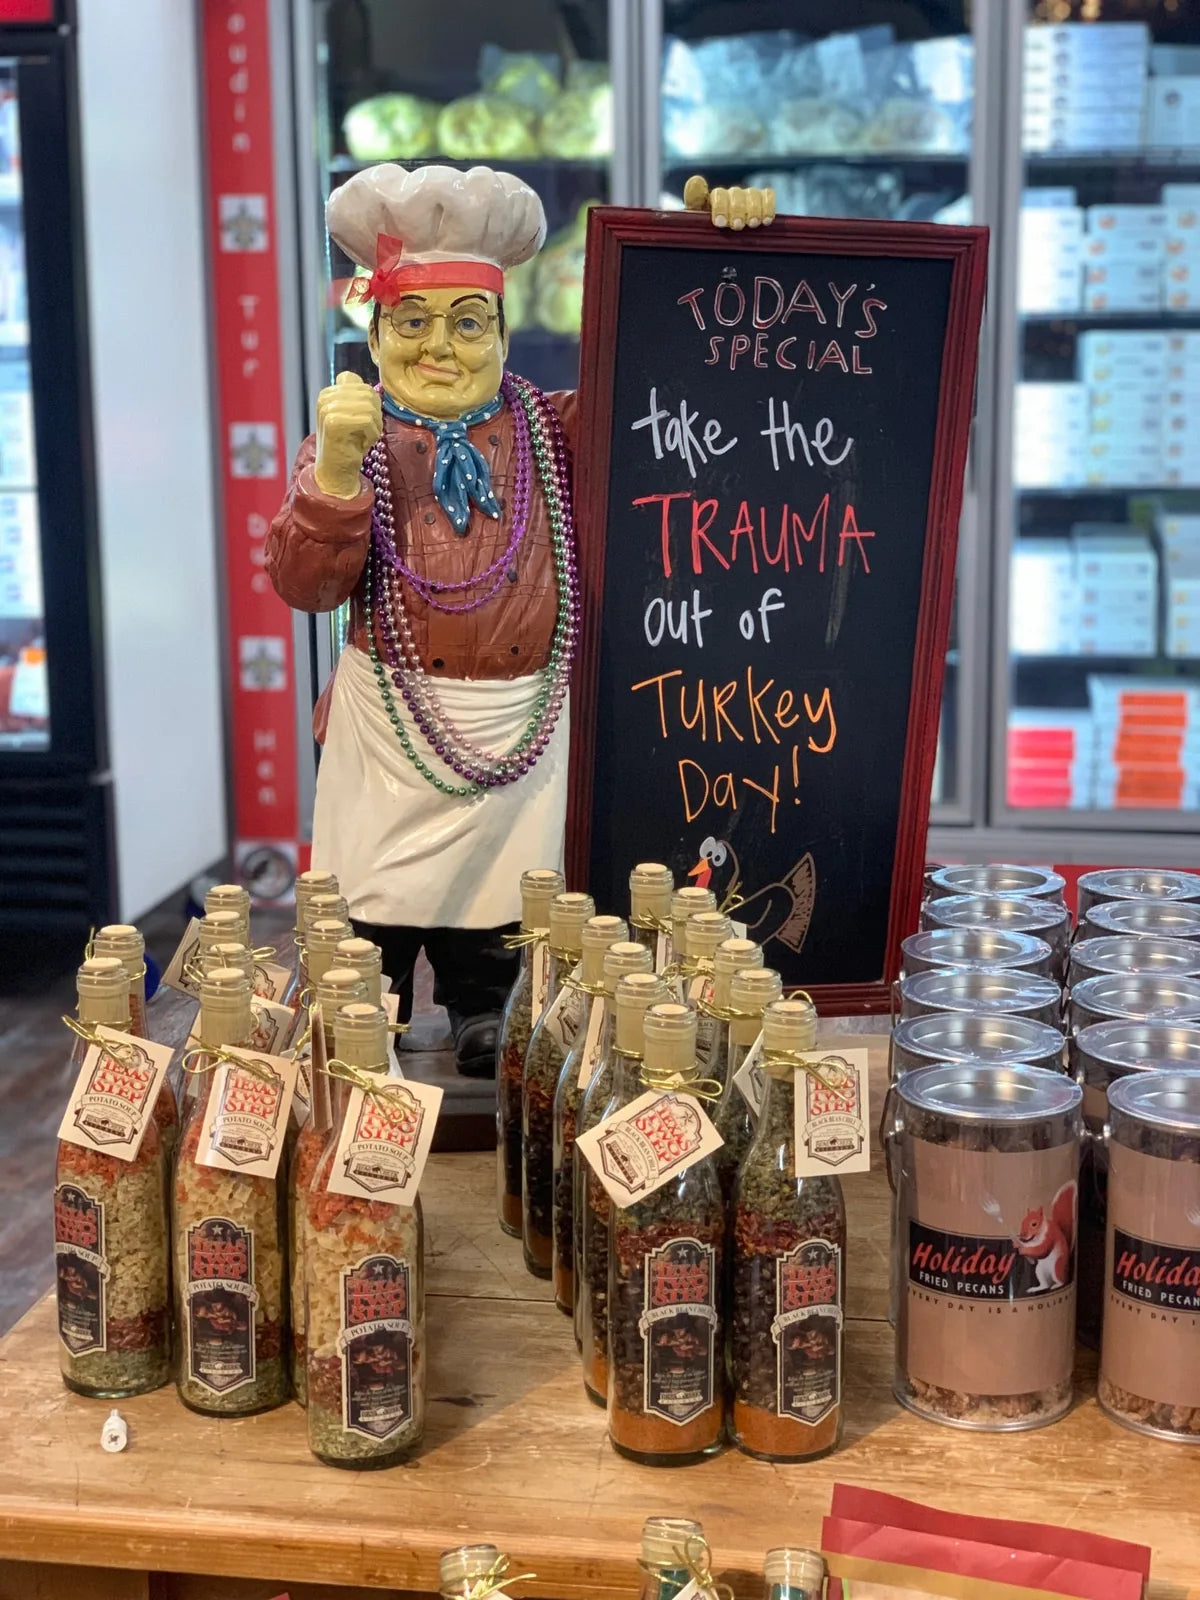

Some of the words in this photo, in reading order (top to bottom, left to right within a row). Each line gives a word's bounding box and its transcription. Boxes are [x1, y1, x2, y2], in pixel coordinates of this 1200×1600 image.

[704, 332, 872, 374] SPECIAL
[631, 386, 738, 478] take
[760, 397, 854, 471] the
[632, 493, 876, 578] TRAUMA
[644, 589, 713, 648] out
[739, 587, 785, 643] of
[99, 1068, 146, 1092] TWO
[230, 1075, 278, 1097] TEXAS
[92, 1080, 143, 1104] STEP
[228, 1088, 276, 1106] TWO
[88, 1095, 118, 1107] POTATO
[119, 1100, 138, 1117] SOUP
[224, 1099, 273, 1120] STEP
[809, 1099, 856, 1116] STEP
[222, 1115, 252, 1125] POTATO
[252, 1119, 272, 1133] SOUP
[647, 1113, 681, 1156] TWO
[359, 1125, 413, 1148] STEP
[635, 1117, 673, 1162] STEP
[357, 1143, 389, 1153] POTATO
[390, 1148, 410, 1162] SOUP
[191, 1236, 247, 1253] TEXAS
[78, 1249, 98, 1263] SOUP
[192, 1252, 247, 1269] TWO
[911, 1241, 1017, 1285] Holiday
[192, 1262, 248, 1280] STEP
[193, 1281, 223, 1291] POTATO
[225, 1281, 248, 1292] SOUP
[919, 1271, 949, 1289] FRIED
[957, 1281, 1005, 1295] PECANS
[1122, 1280, 1152, 1298] FRIED
[652, 1286, 708, 1306] STEP
[349, 1301, 405, 1323] STEP
[947, 1302, 975, 1312] DAY
[988, 1305, 1002, 1314] IS
[1150, 1312, 1179, 1324] DAY
[350, 1322, 385, 1337] POTATO
[387, 1320, 406, 1329] SOUP
